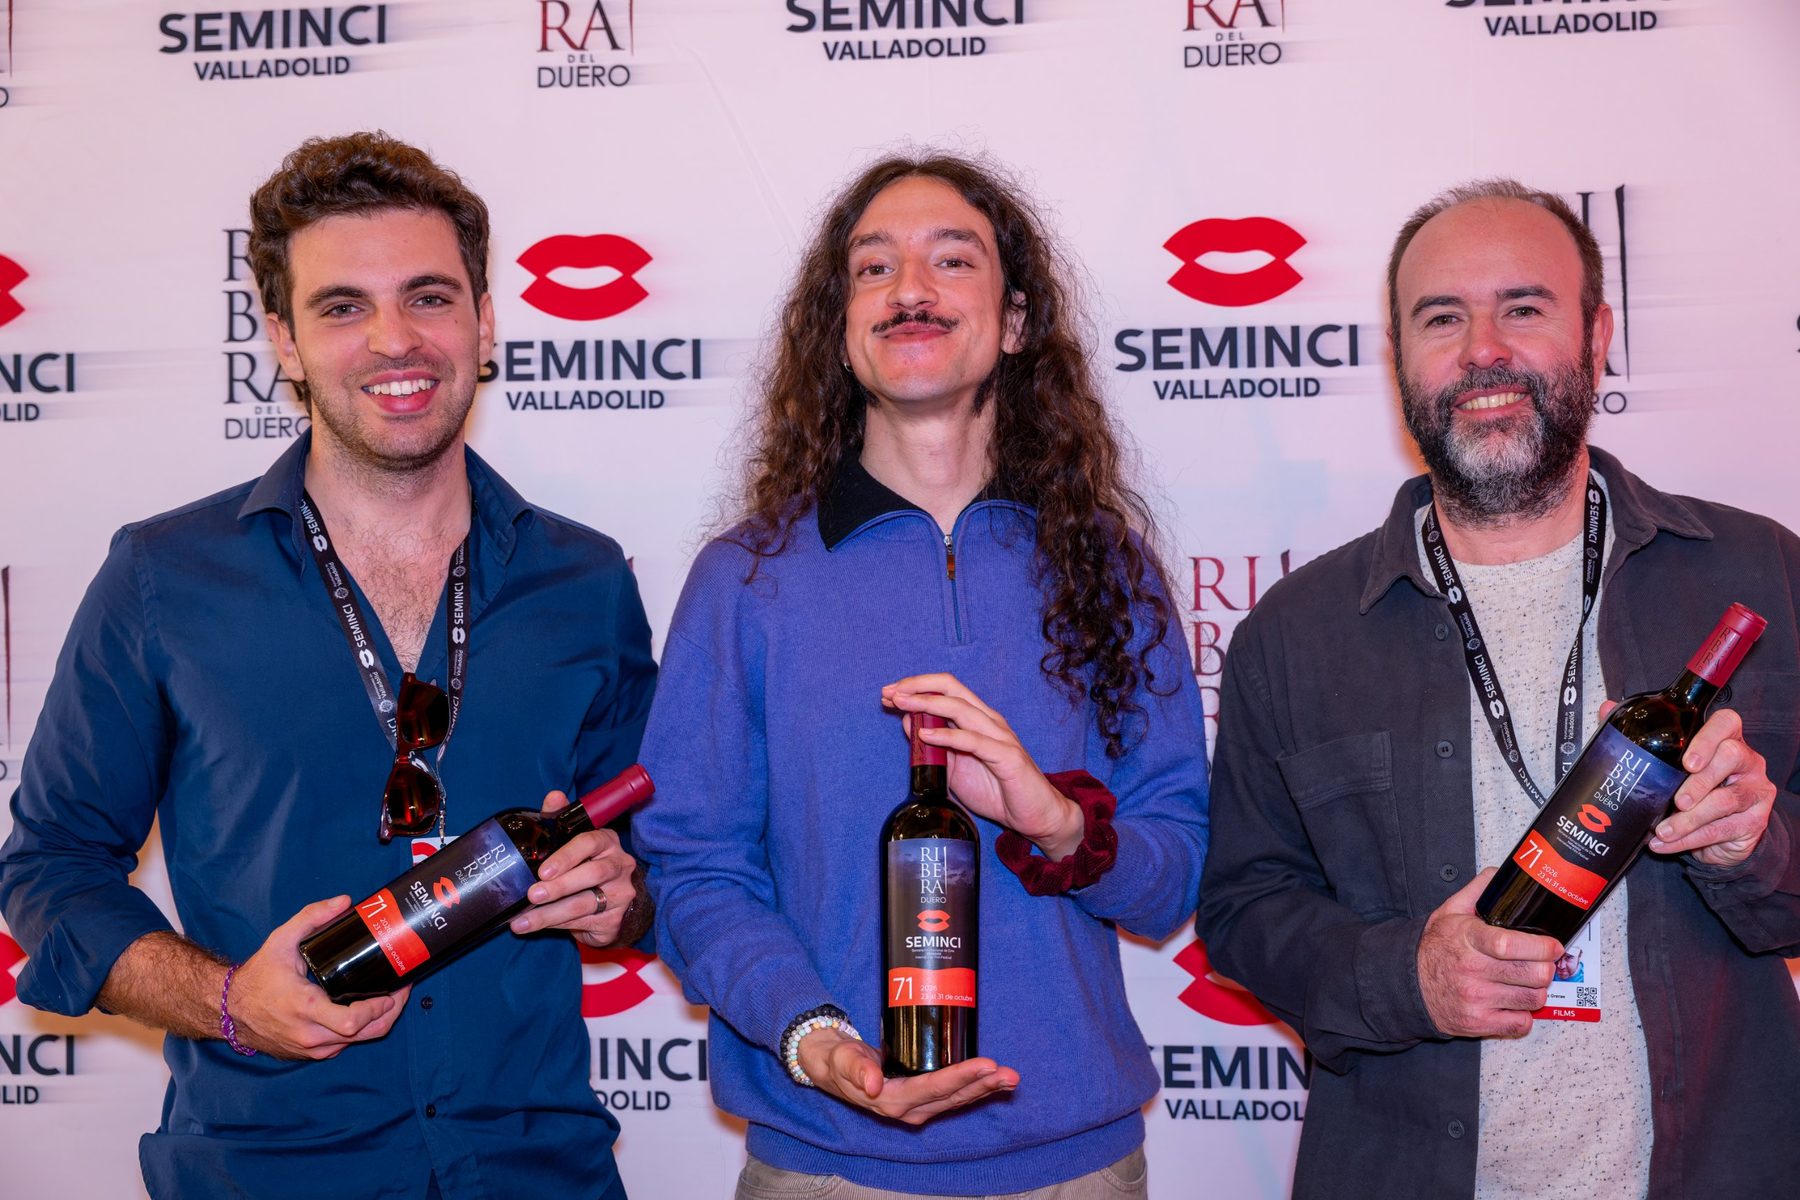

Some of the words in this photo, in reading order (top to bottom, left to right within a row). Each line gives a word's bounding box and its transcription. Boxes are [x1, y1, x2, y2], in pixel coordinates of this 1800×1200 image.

[786, 0, 1024, 33] SEMINCI
[1484, 10, 1657, 37] VALLADOLID
[159, 4, 387, 54] SEMINCI
[1215, 32, 1244, 42] DEL
[568, 54, 595, 63] DEL
[822, 37, 986, 60] VALLADOLID
[1184, 42, 1282, 68] DUERO
[194, 56, 350, 80] VALLADOLID
[537, 64, 630, 88] DUERO
[1114, 323, 1359, 372] SEMINCI
[506, 390, 665, 410] VALLADOLID
[1153, 377, 1321, 400] VALLADOLID
[254, 406, 283, 415] DEL
[300, 499, 321, 535] SEMINC
[1588, 505, 1599, 543] SEMINCI
[1433, 545, 1455, 586] SEMINCI
[453, 582, 464, 624] SEMINCI
[342, 603, 367, 648] SEMINCI
[1567, 635, 1578, 683] SEMIN
[1474, 654, 1497, 699] SEMINCI
[1619, 749, 1643, 772] RI
[1518, 767, 1545, 805] EMINCI
[1609, 763, 1635, 787] BE
[1593, 791, 1619, 811] DUERO
[1600, 777, 1623, 803] RA
[1556, 815, 1610, 856] SEMINCI
[920, 847, 939, 862] RI
[1520, 839, 1543, 869] 71
[920, 863, 942, 878] BE
[1542, 863, 1558, 878] 2026
[920, 880, 944, 895] RA
[1537, 871, 1546, 879] 23
[1559, 886, 1567, 894] de
[1567, 891, 1589, 905] octubre
[362, 895, 388, 918] 71
[410, 880, 448, 931] SEMINCI
[905, 936, 961, 949] SEMINCI
[391, 949, 406, 971] octubre
[892, 977, 913, 1001] 71
[1553, 1009, 1576, 1017] FILMS
[600, 1037, 708, 1082] INCI
[1149, 1045, 1311, 1090] EMIN
[1165, 1098, 1304, 1122] VALLADOL
